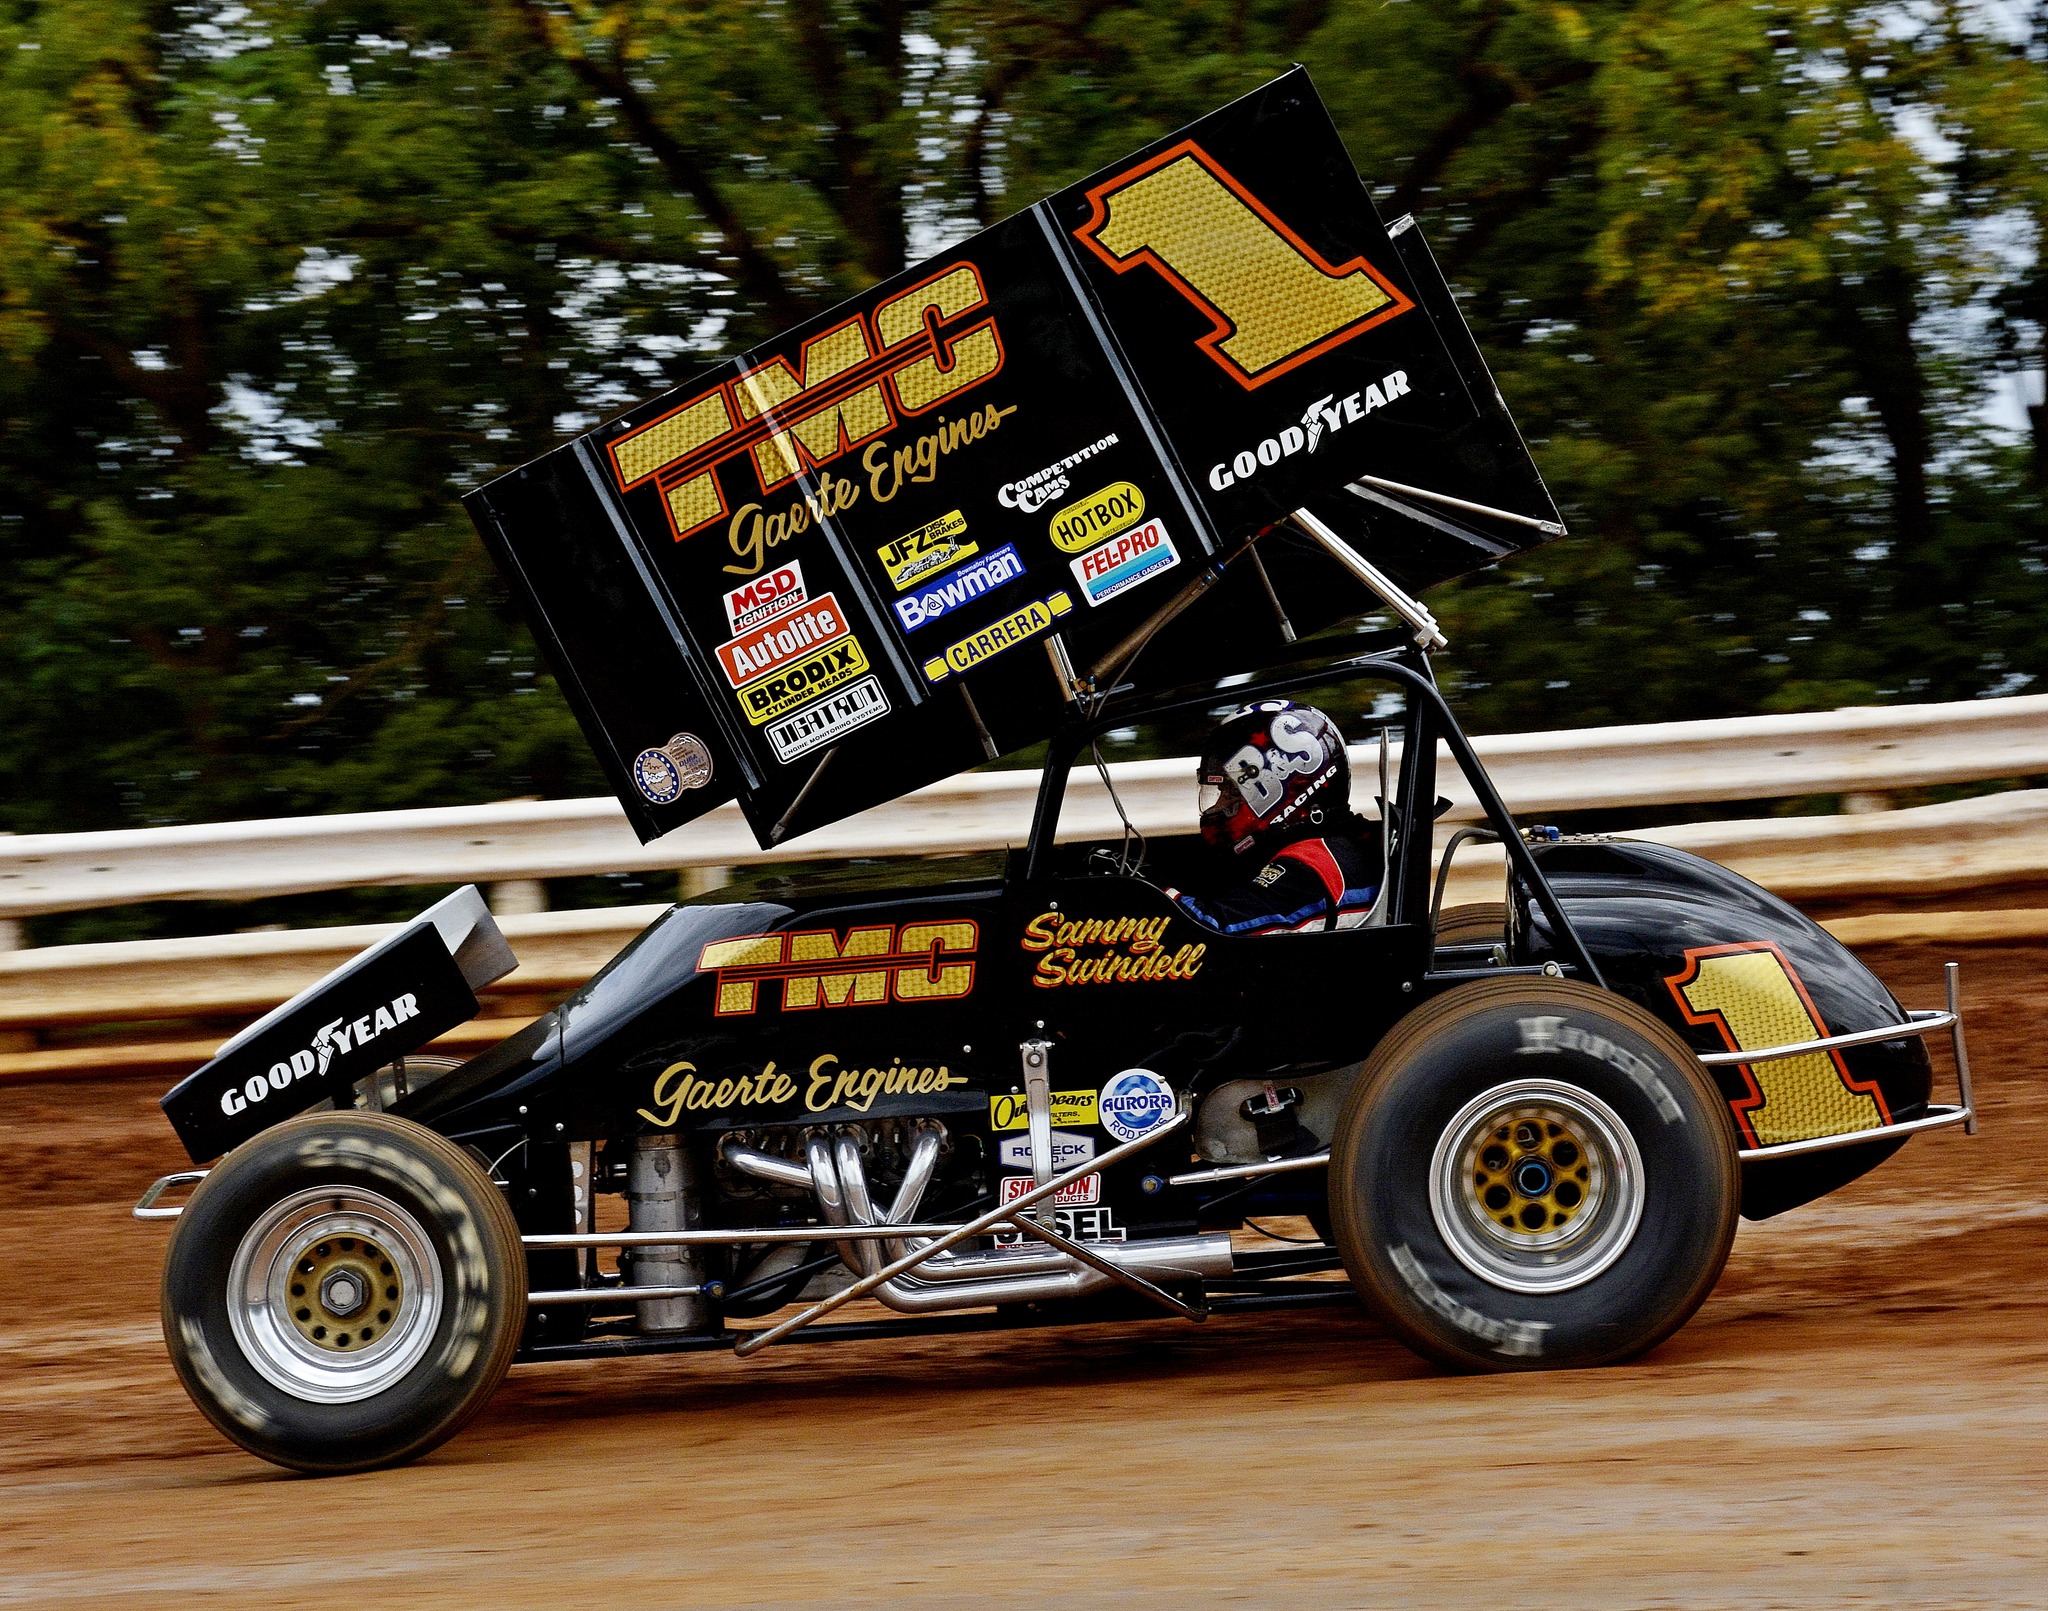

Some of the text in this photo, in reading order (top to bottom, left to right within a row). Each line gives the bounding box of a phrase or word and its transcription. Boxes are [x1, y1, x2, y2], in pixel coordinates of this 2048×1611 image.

[1072, 139, 1416, 391] 1
[606, 261, 1004, 542] TMC
[1209, 370, 1411, 491] GOODYEAR
[723, 404, 1017, 574] Gaerte Engines
[997, 433, 1119, 508] COMPETITION
[1019, 474, 1070, 513] CAMS
[926, 518, 947, 533] DISC
[929, 518, 965, 540] BRAKES
[1056, 488, 1138, 545] HOTBOX
[886, 528, 934, 568] JFZ
[1082, 525, 1159, 580] FEL-PRO
[731, 569, 796, 617] MSD
[895, 552, 1022, 630] Bowman
[1096, 557, 1170, 600] PERFORMANCE GASKETS
[738, 592, 799, 628] IGNITION
[952, 606, 1047, 667] CARRERA
[731, 609, 837, 678] Autolite
[747, 644, 857, 712] BRODIX
[765, 667, 853, 716] CYLINDER HEADS
[773, 683, 879, 748] DIGATRON
[784, 704, 884, 757] ENGINE MONITORING SYSTEMS
[1270, 765, 1338, 825] RACING
[1021, 911, 1172, 952] Sammy
[696, 919, 979, 1017] TMC
[1032, 942, 1206, 988] Swindell
[220, 992, 420, 1116] GOODYEAR
[1664, 941, 1893, 1150] 1
[636, 1054, 969, 1129] Gaerte Engines
[1102, 1094, 1172, 1113] AURORA
[1012, 1144, 1086, 1157] ROECK
[1109, 1120, 1135, 1140] ROD
[1008, 1176, 1092, 1199] SION
